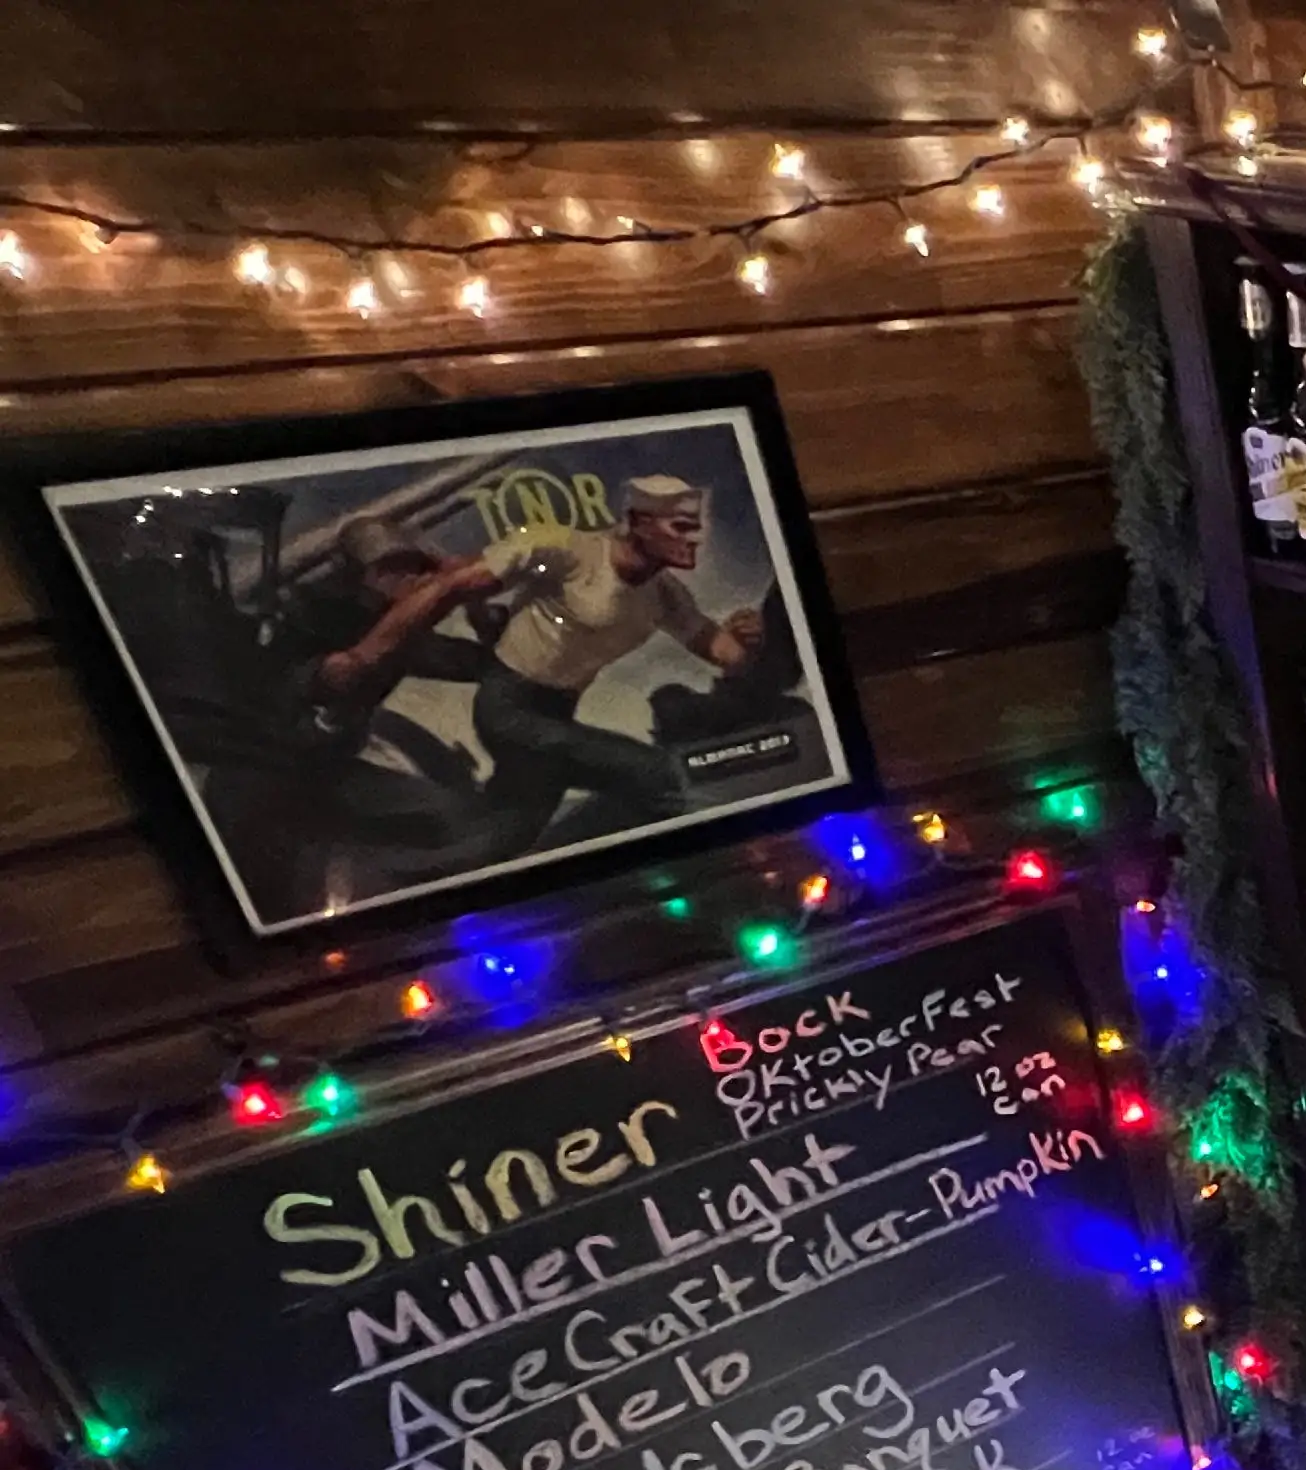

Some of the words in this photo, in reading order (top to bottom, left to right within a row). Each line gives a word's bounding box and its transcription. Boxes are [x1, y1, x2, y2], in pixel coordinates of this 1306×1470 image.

[733, 1064, 893, 1140] Prickly
[908, 1022, 1003, 1076] Pear
[263, 1101, 678, 1286] Shiner
[347, 1232, 617, 1368] Miller
[642, 1134, 857, 1257] Light
[388, 1348, 569, 1458] Ace
